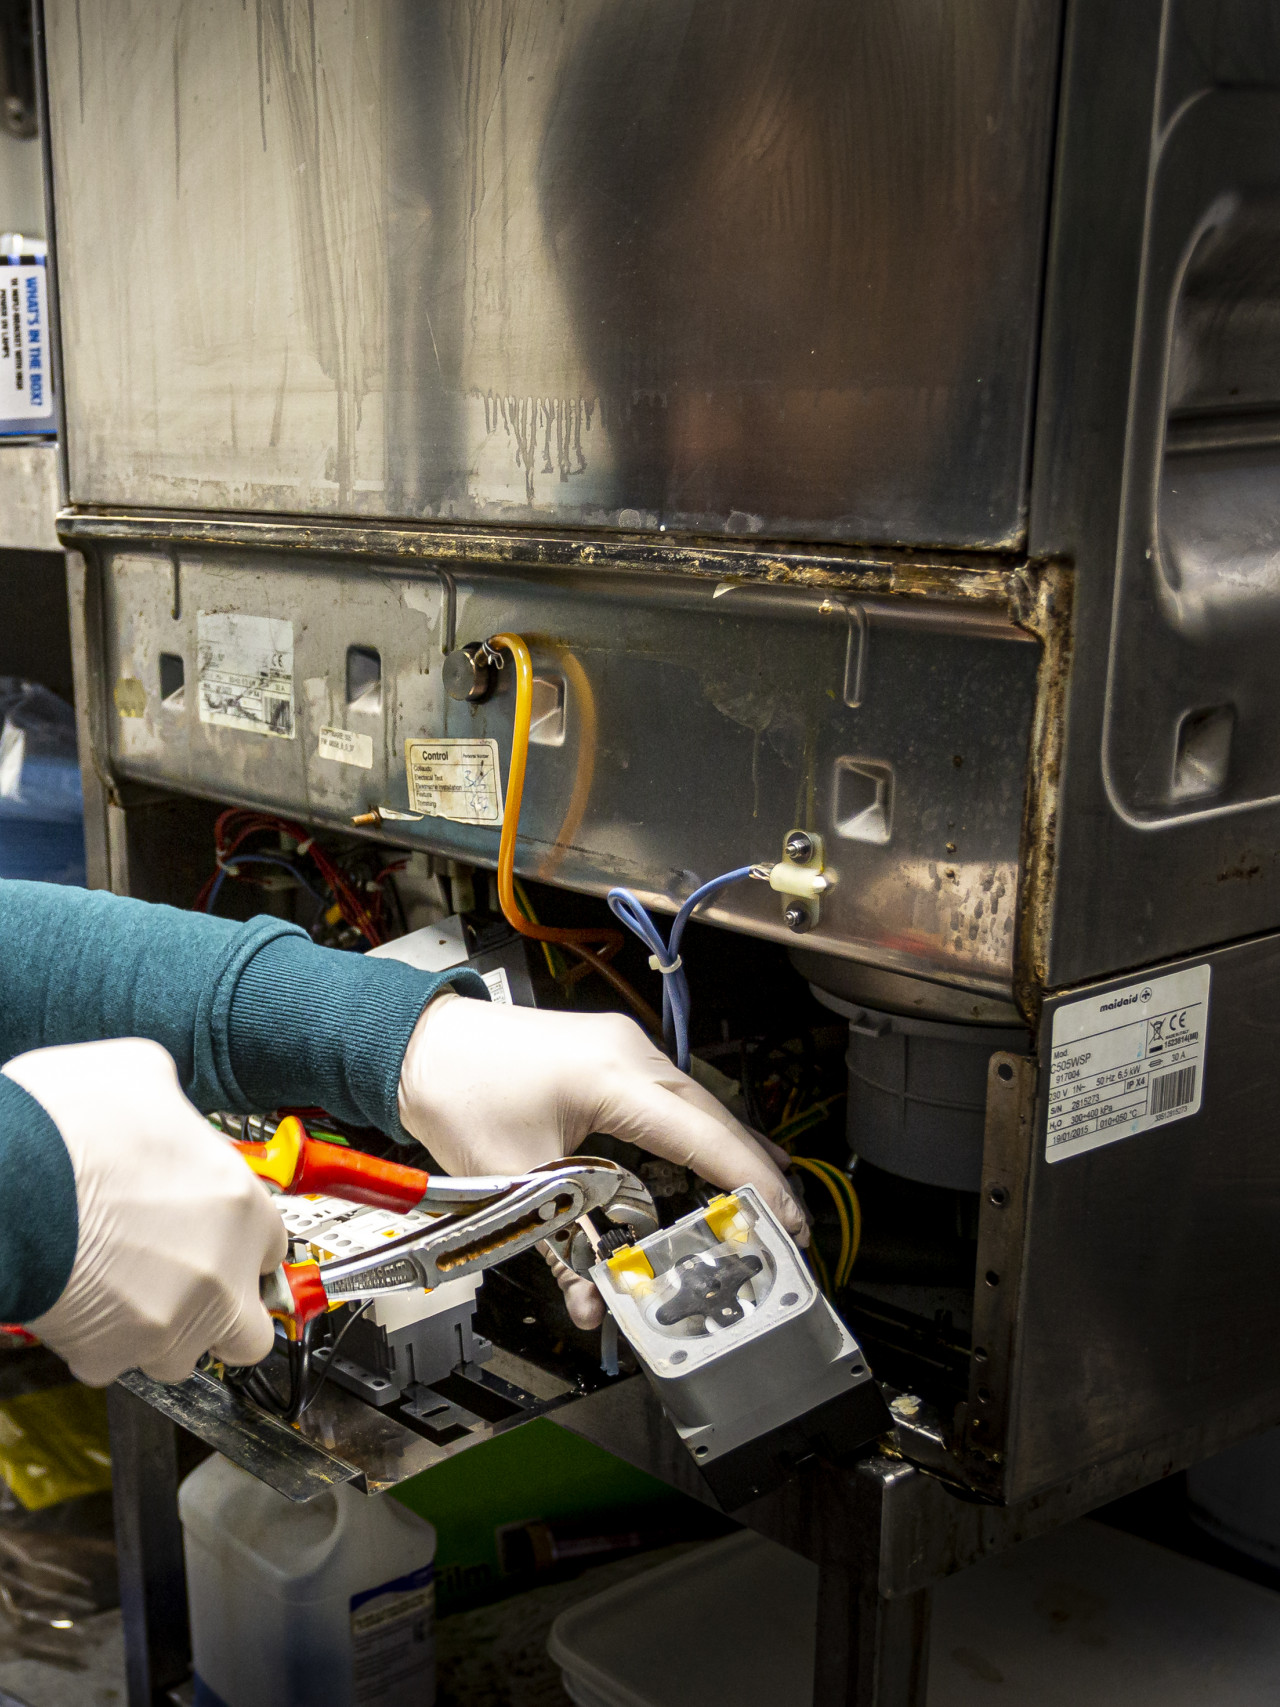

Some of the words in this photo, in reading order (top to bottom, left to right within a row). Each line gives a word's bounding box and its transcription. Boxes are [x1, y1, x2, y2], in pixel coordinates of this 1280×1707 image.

[25, 277, 40, 326] WHAT'S
[28, 329, 40, 343] IN
[29, 347, 42, 369] THE
[422, 751, 449, 761] Control
[1100, 993, 1138, 1012] maidaid
[1051, 1053, 1091, 1074] C505WSP
[1056, 1069, 1080, 1084] 917004
[1063, 1088, 1069, 1097] V
[1096, 1077, 1105, 1087] 50
[1106, 1074, 1115, 1084] Hz
[1129, 1065, 1141, 1076] kW
[1172, 1052, 1179, 1062] 30
[1180, 1051, 1186, 1059] A
[1126, 1080, 1134, 1090] IP
[1136, 1077, 1145, 1087] X4
[1050, 1104, 1062, 1115] S/N
[1100, 1104, 1113, 1115] kPa
[1053, 1125, 1089, 1144] 19/01/2015
